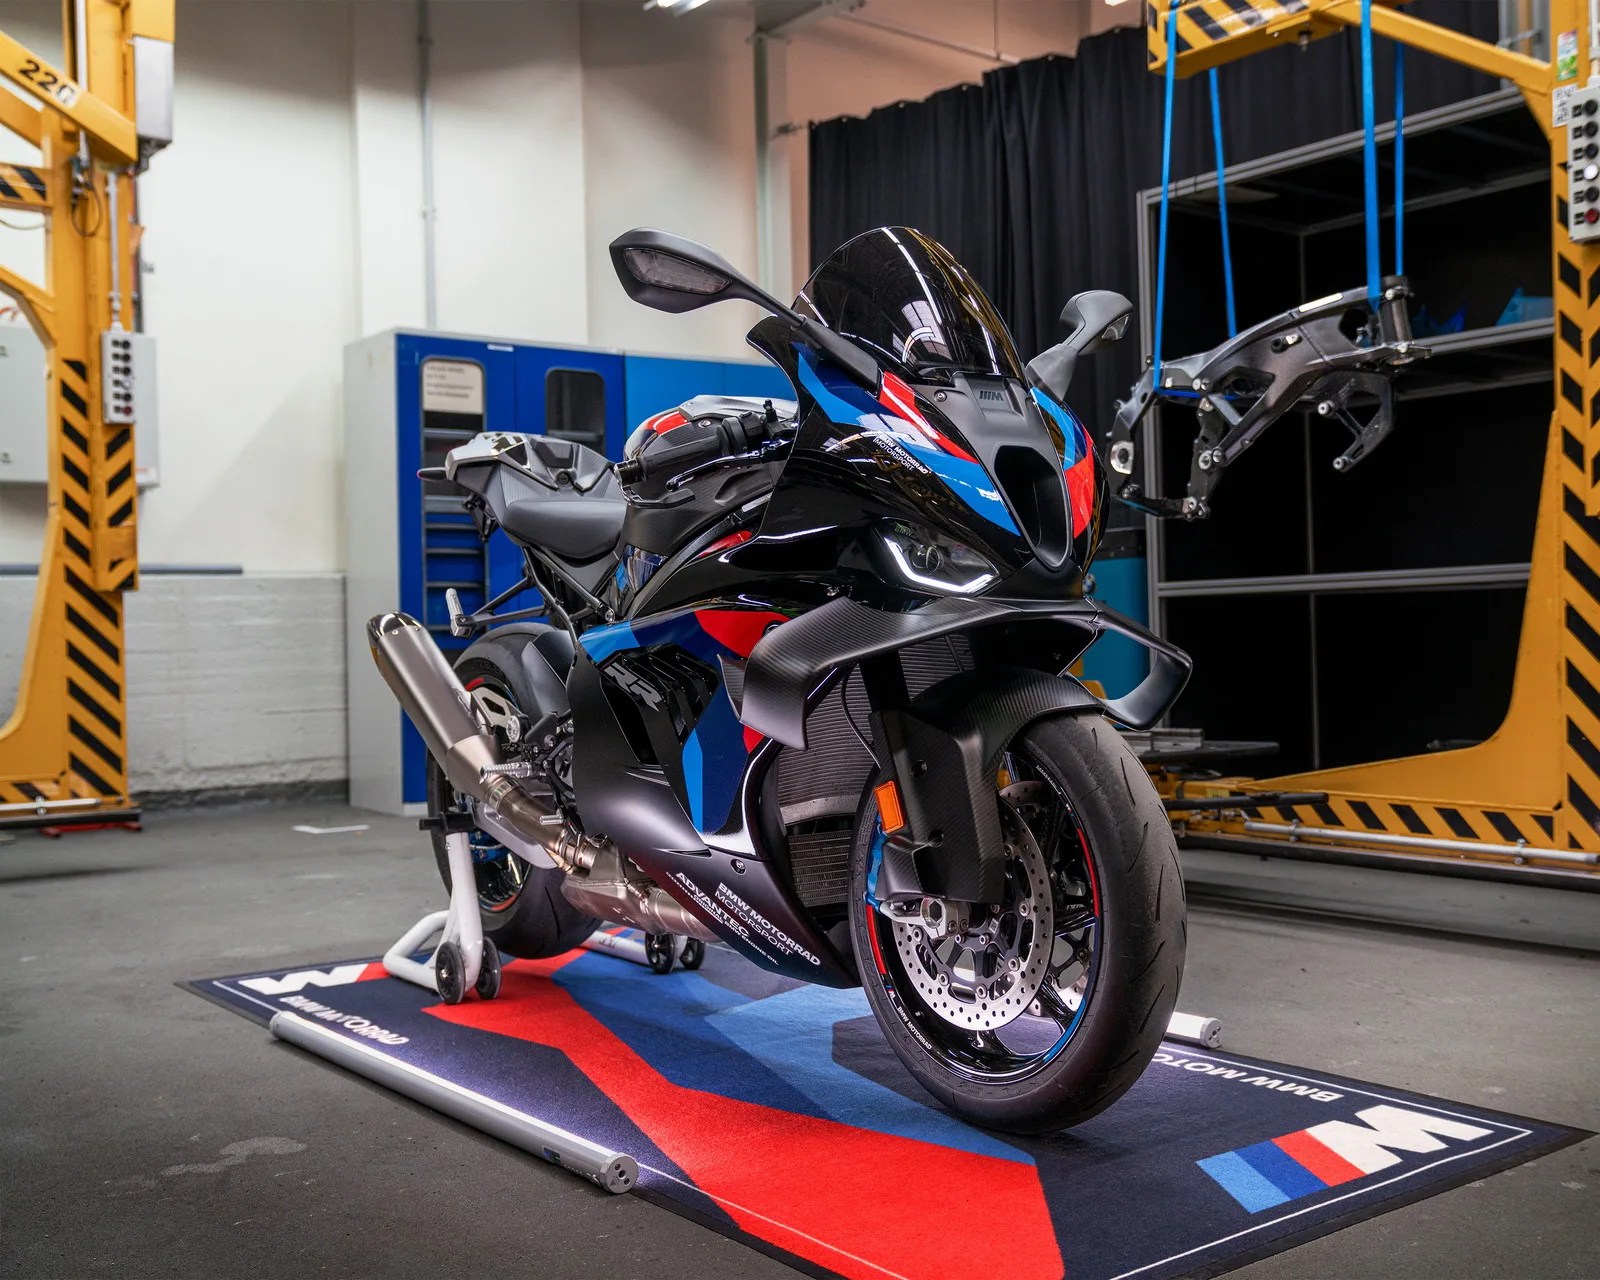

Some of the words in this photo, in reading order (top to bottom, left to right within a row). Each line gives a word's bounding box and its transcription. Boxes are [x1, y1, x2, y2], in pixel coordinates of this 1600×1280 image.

[874, 437, 915, 472] MOTORSPORT
[894, 446, 929, 474] MOTORRAD
[603, 662, 663, 711] RR
[676, 872, 749, 937] ADVANTEC
[715, 891, 793, 956] MOTORSPORT
[719, 882, 751, 911] BMW
[750, 909, 821, 965] MOTORRAD
[741, 935, 767, 956] ENGINE
[898, 1006, 909, 1021] BMW
[907, 1021, 932, 1050] MOTORRAD
[1239, 1076, 1344, 1102] BMW
